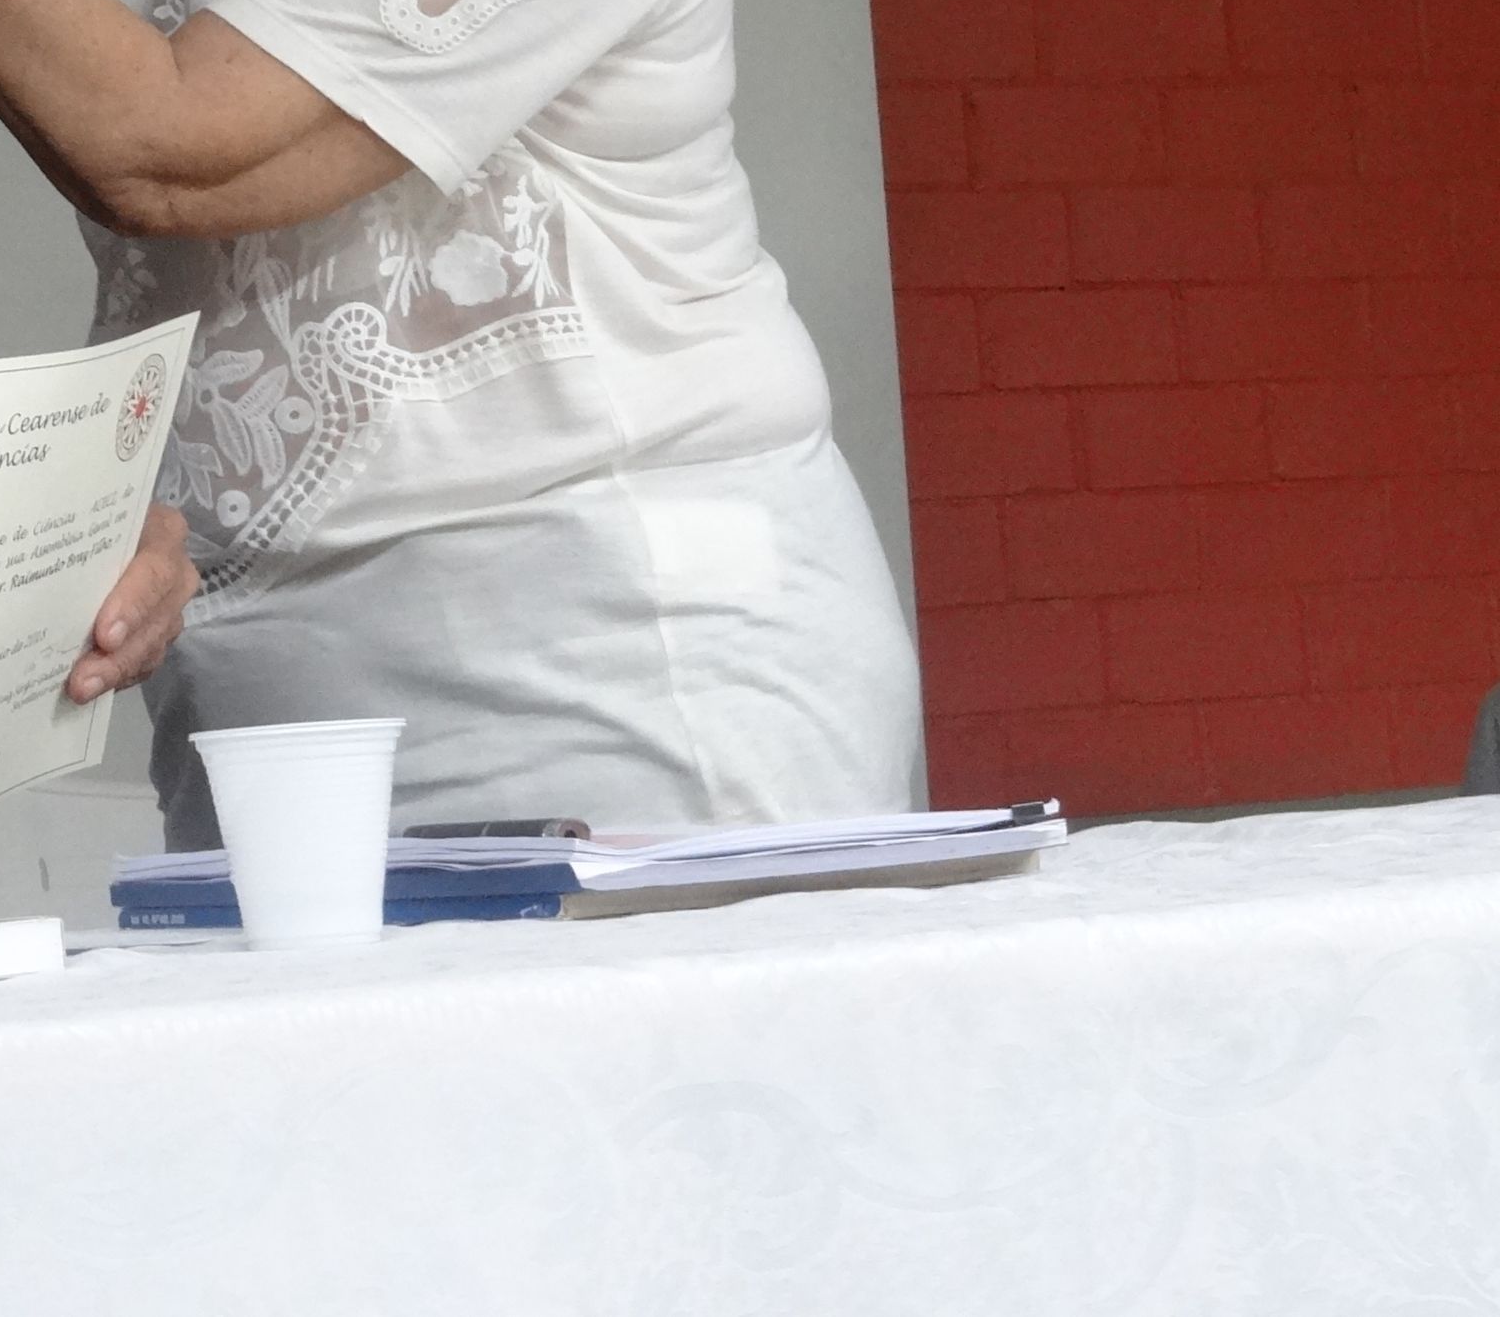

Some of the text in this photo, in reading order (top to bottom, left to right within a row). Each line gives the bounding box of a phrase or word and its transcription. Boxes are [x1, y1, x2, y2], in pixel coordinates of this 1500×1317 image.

[7, 404, 88, 436] Cearense
[90, 392, 111, 418] de
[12, 524, 29, 542] de
[5, 551, 27, 570] sua
[10, 557, 66, 591] Raimundo
